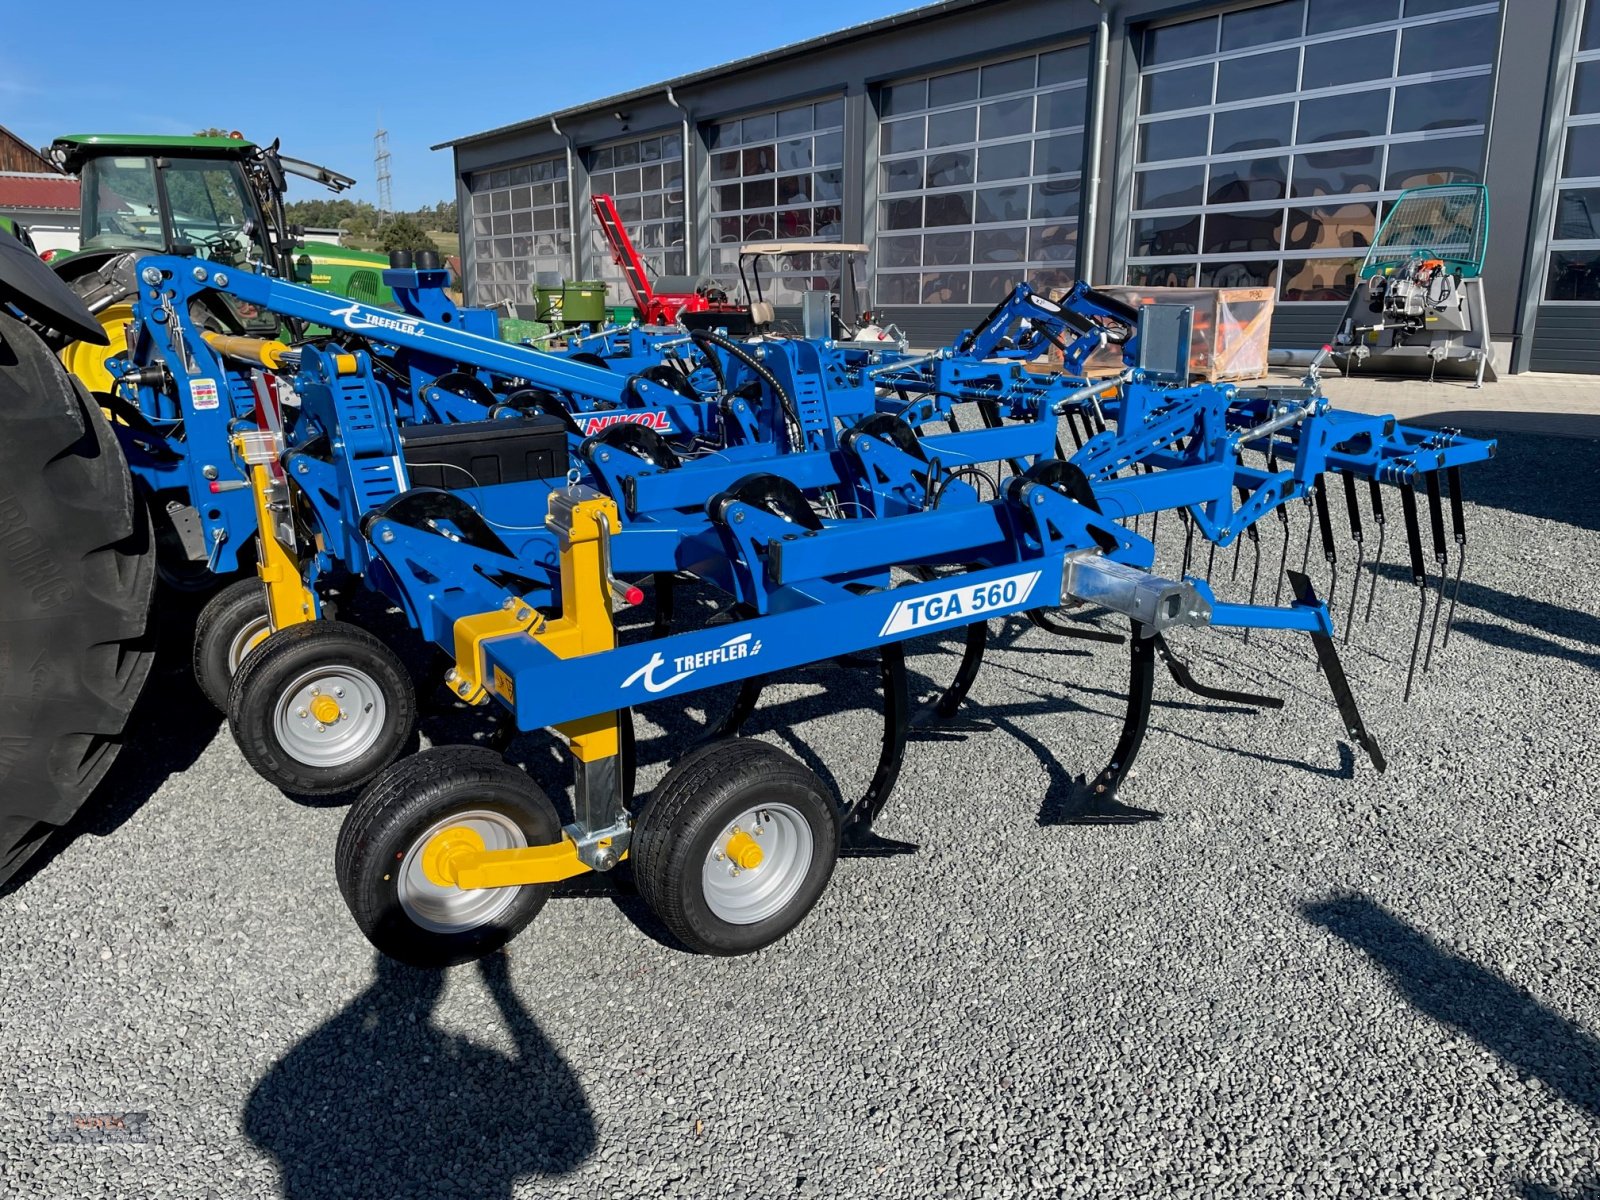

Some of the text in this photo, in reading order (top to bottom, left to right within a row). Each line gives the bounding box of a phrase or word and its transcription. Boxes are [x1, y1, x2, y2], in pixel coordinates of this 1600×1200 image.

[365, 313, 415, 335] TREFFLER
[907, 580, 1017, 626] TGA 560
[674, 643, 748, 673] TREFFLER
